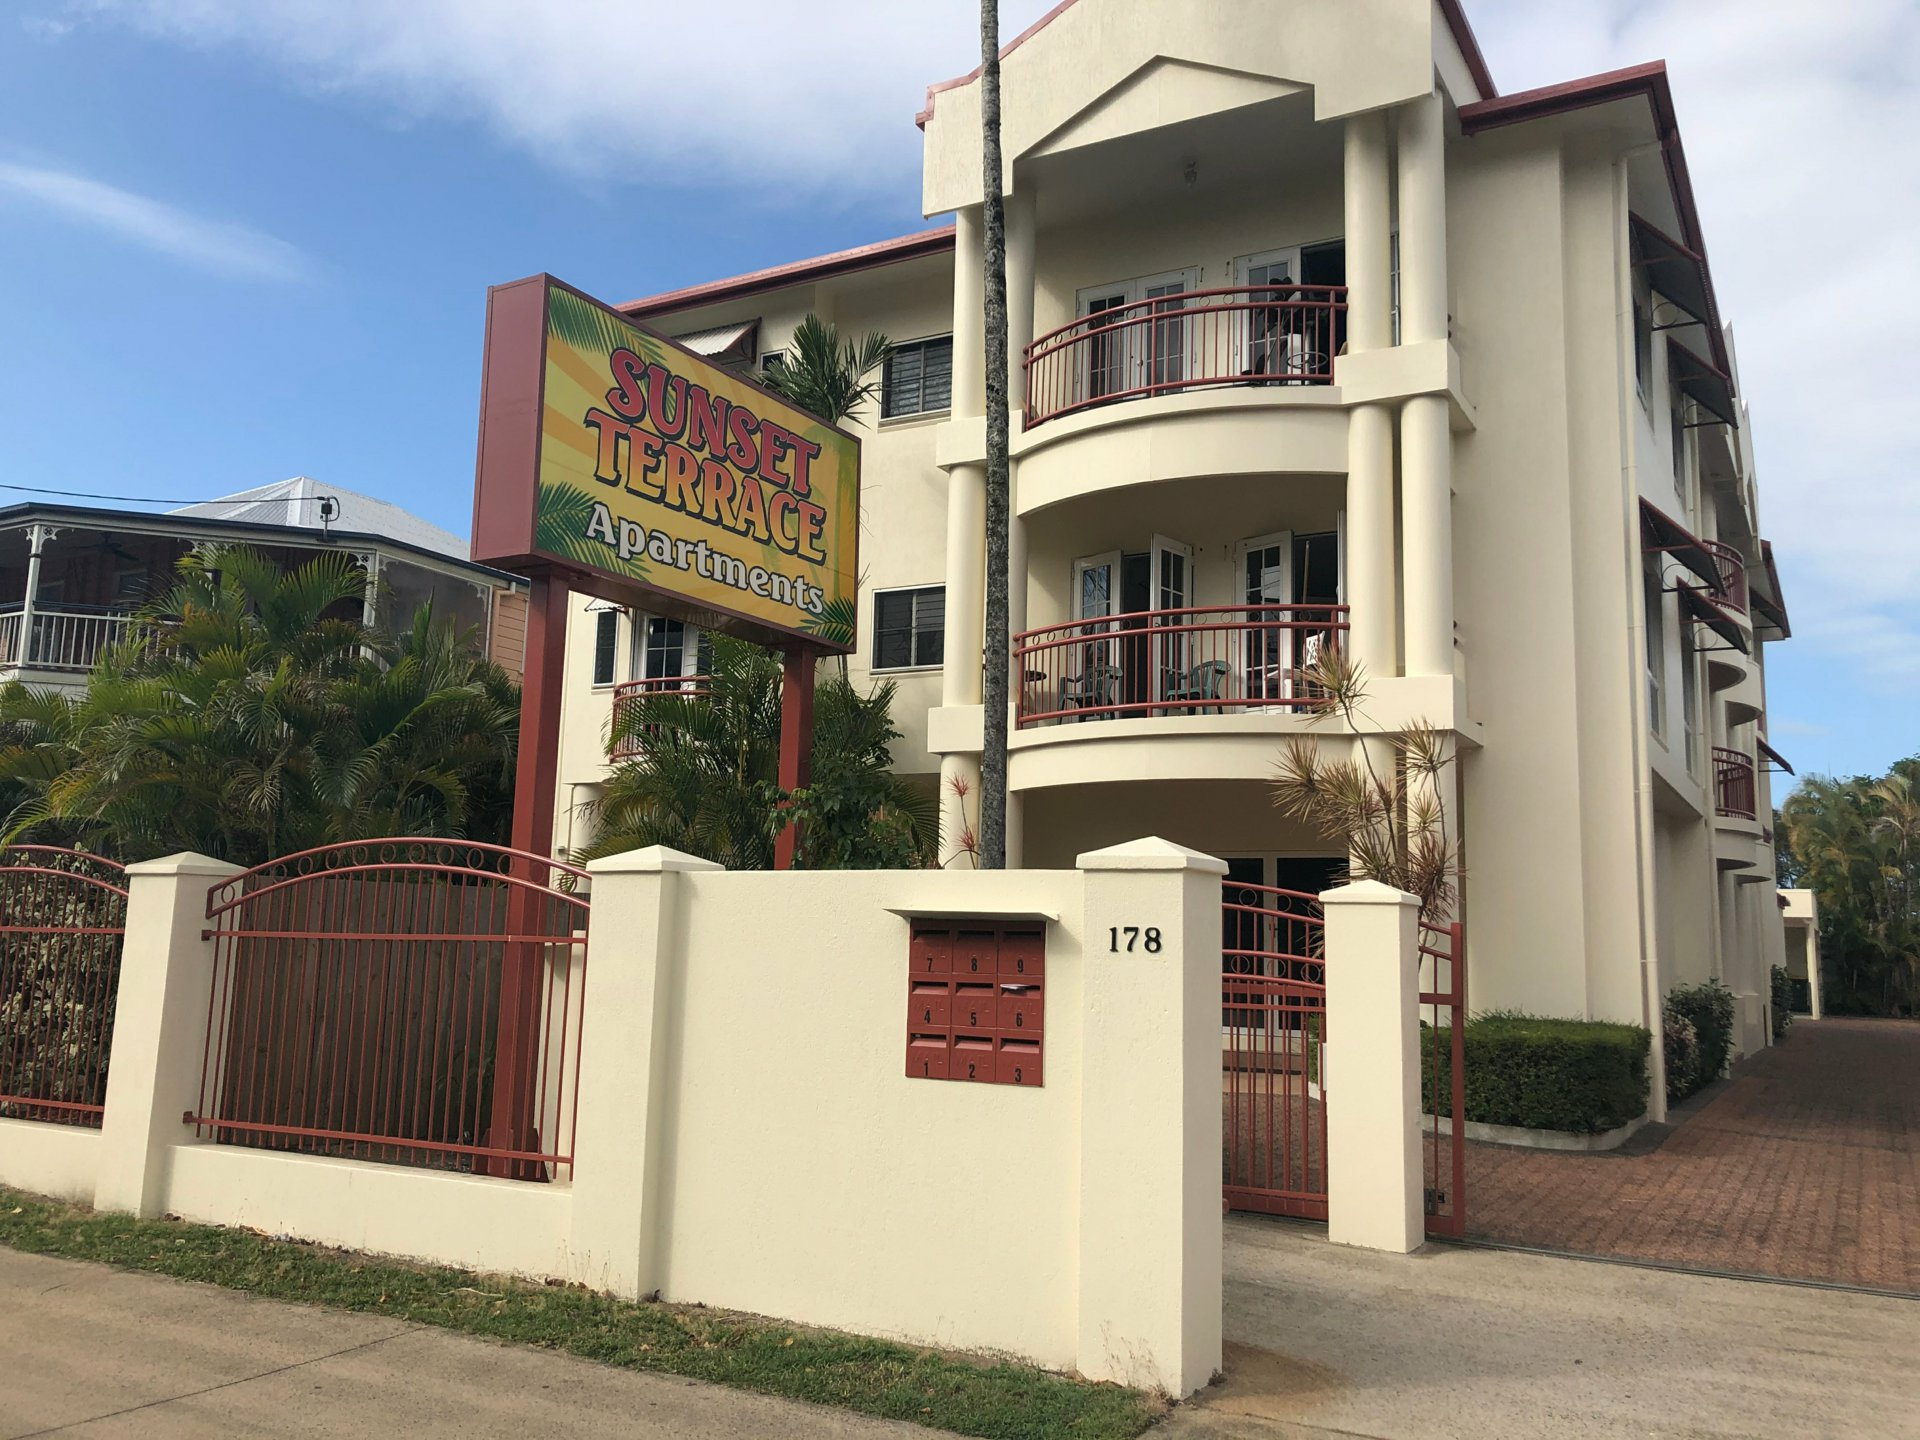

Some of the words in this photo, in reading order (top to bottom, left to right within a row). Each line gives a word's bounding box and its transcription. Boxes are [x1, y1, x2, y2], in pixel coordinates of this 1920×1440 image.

[605, 347, 821, 498] SUNSET
[584, 407, 827, 565] TERRACE
[585, 502, 825, 615] Apartments
[1108, 926, 1163, 953] 178
[926, 957, 933, 972] 7
[970, 957, 978, 972] 8
[1017, 959, 1024, 973] 9
[924, 1009, 931, 1024] 4
[970, 1012, 977, 1026] 5
[1016, 1013, 1023, 1027] 6
[923, 1062, 929, 1077] 1
[968, 1063, 976, 1078] 2
[1014, 1067, 1022, 1082] 3
